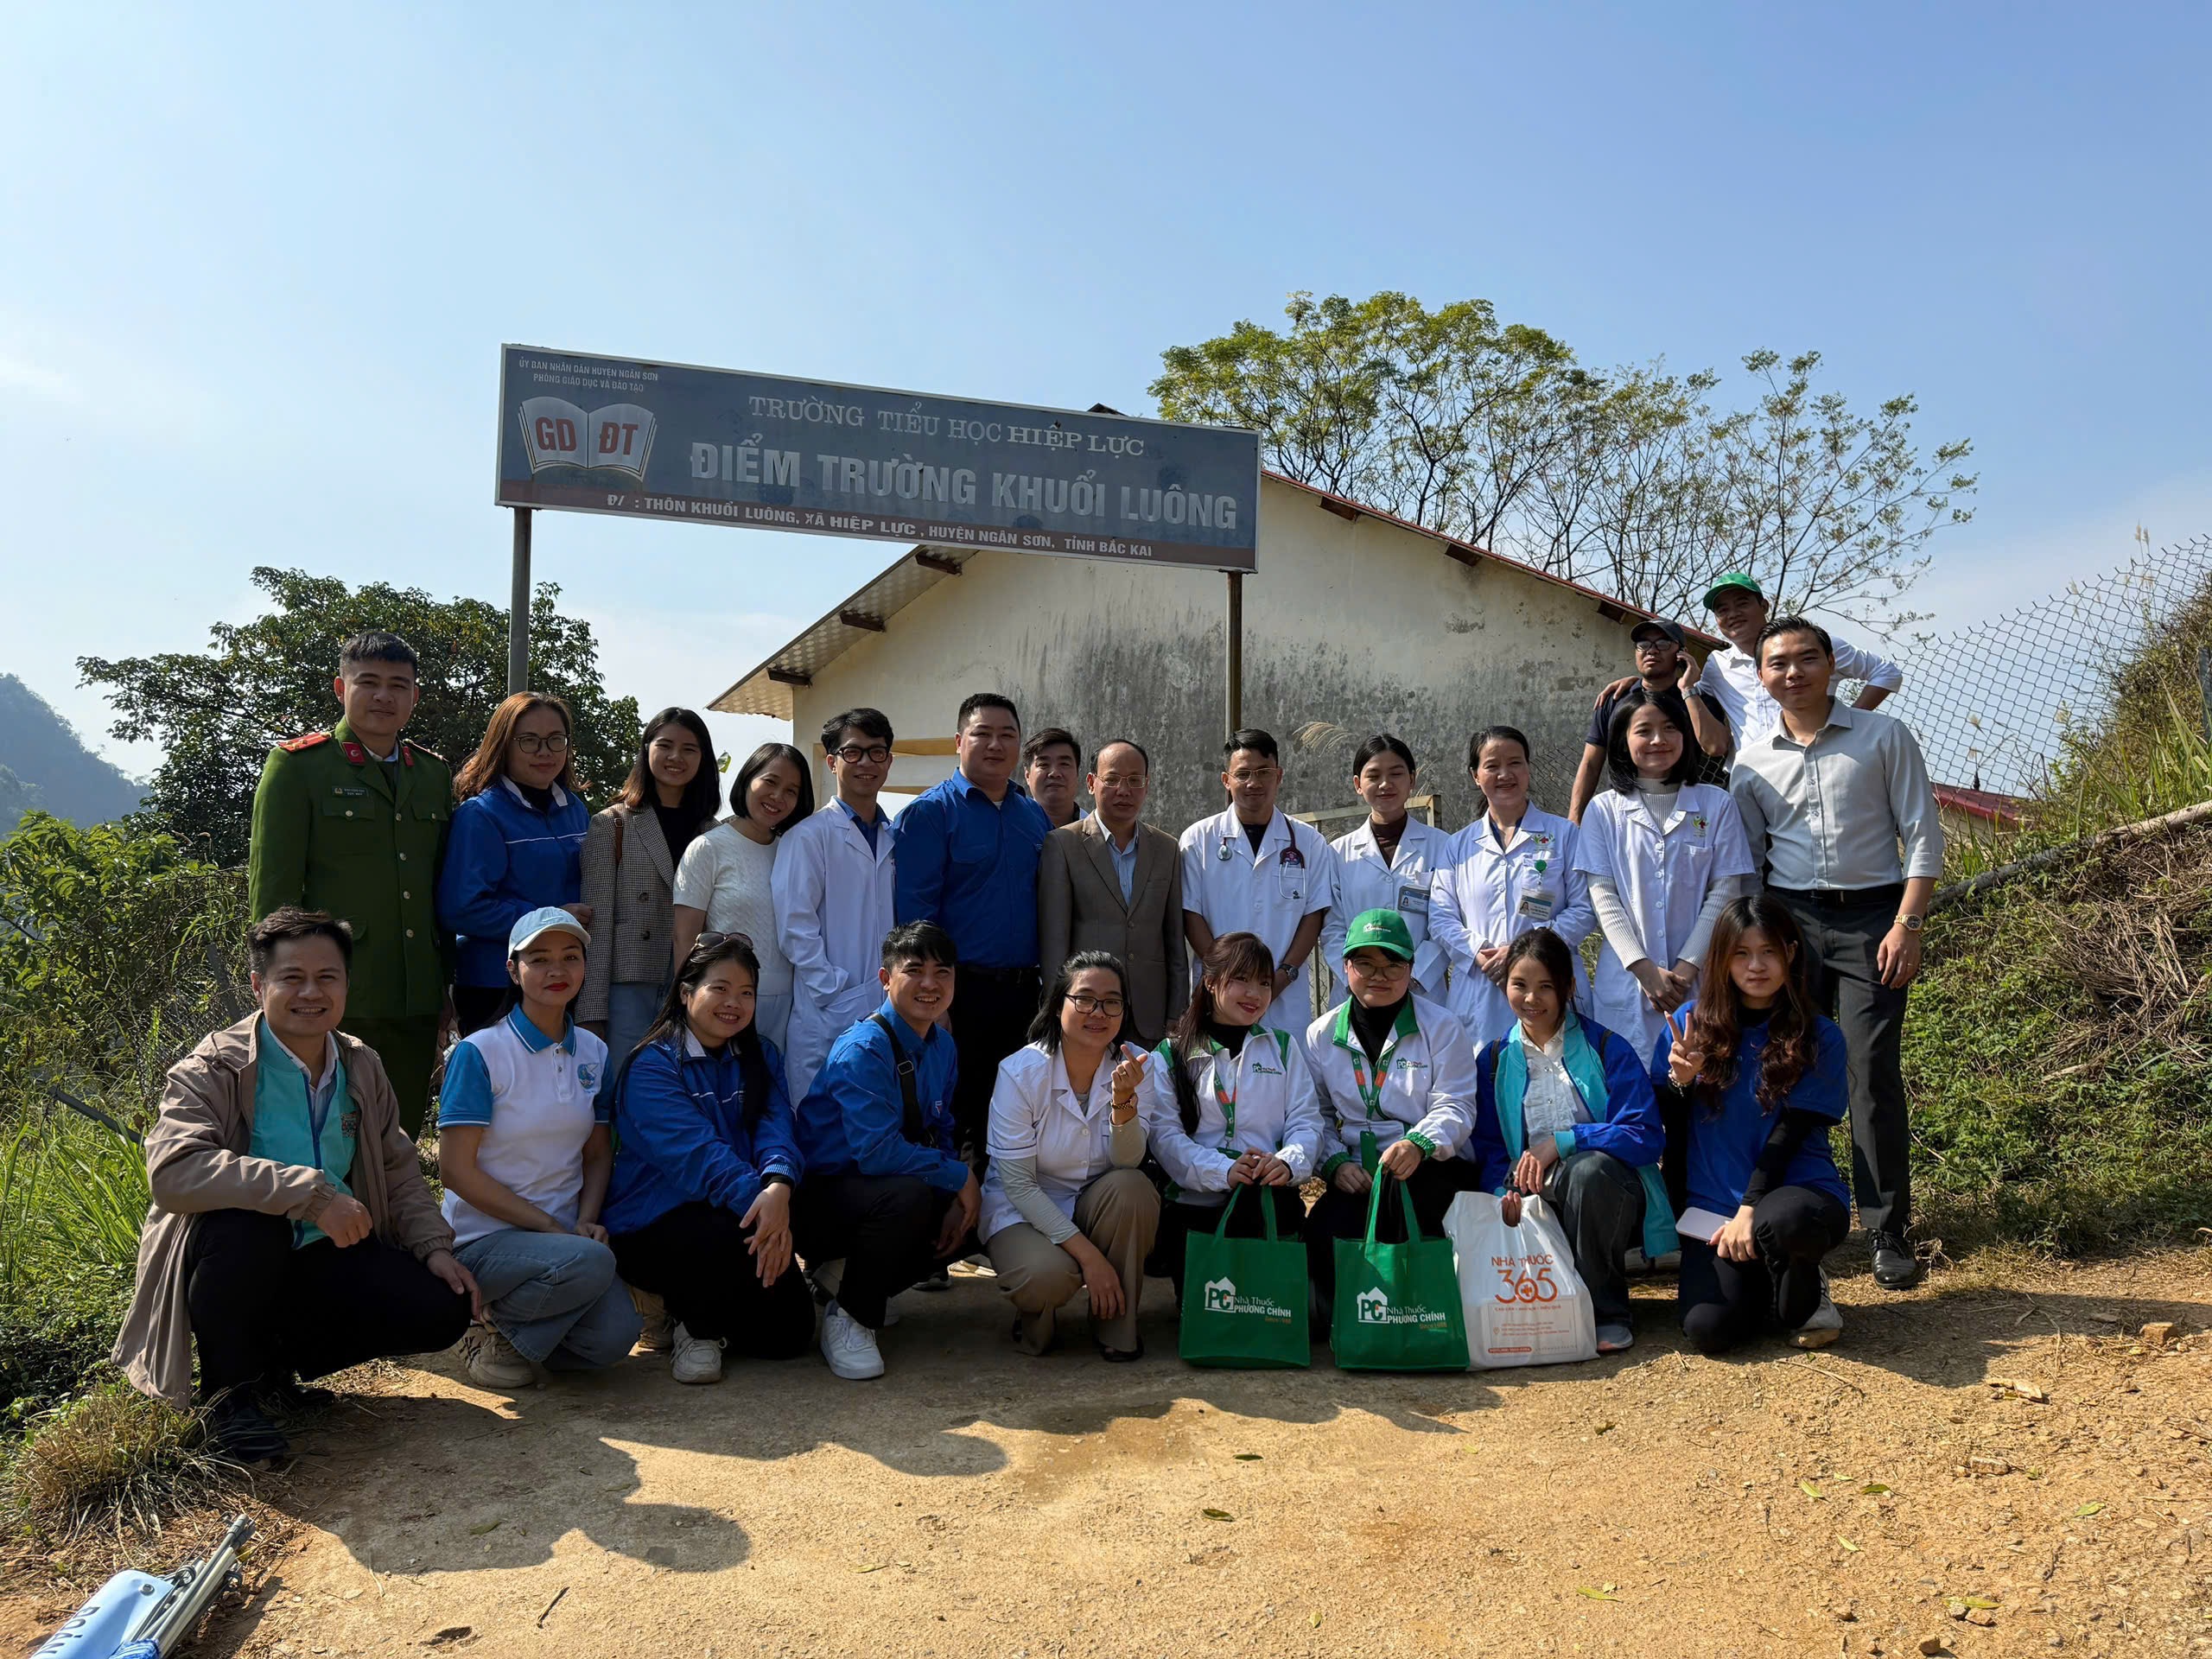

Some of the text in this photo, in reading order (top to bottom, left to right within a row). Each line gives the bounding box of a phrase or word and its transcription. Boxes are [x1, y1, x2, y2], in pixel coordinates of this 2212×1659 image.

[531, 360, 548, 370] BAN
[550, 361, 571, 372] NHÂN
[592, 365, 617, 378] HUYỆN
[619, 367, 640, 380] NGÂN
[642, 372, 658, 381] SƠN
[533, 373, 560, 384] PHÒNG
[563, 375, 581, 386] GIÁO
[582, 378, 598, 389] DỤC
[601, 378, 610, 389] VÀ
[630, 383, 644, 393] TẠO
[535, 416, 577, 452] GD
[748, 395, 1145, 459] TRƯỜNG TIỂU HỌC HIỆP LỰC
[599, 422, 639, 455] ĐT
[690, 433, 1237, 530] ĐIỂM TRƯỜNG KHUỔI LUÔNG
[644, 497, 686, 512] THÔN
[690, 500, 738, 517] KHUỔI
[804, 512, 825, 526] XÃ
[830, 516, 874, 531] HIỆP
[880, 521, 916, 537] LỰC
[928, 525, 975, 542] HUYỆN
[978, 530, 1018, 545] NGÂN
[1064, 535, 1095, 552] TỈNH
[1491, 1255, 1516, 1267] NHÀ
[1494, 1268, 1558, 1304] 365
[1209, 1287, 1231, 1310] PC
[1234, 1295, 1275, 1307] Nhà Thuốc
[1386, 1304, 1427, 1315] Nhà Thuốc
[1234, 1305, 1292, 1318] PHƯƠNG CHÍNH
[1361, 1299, 1383, 1321] PC
[1420, 1311, 1446, 1322] CHÍNH
